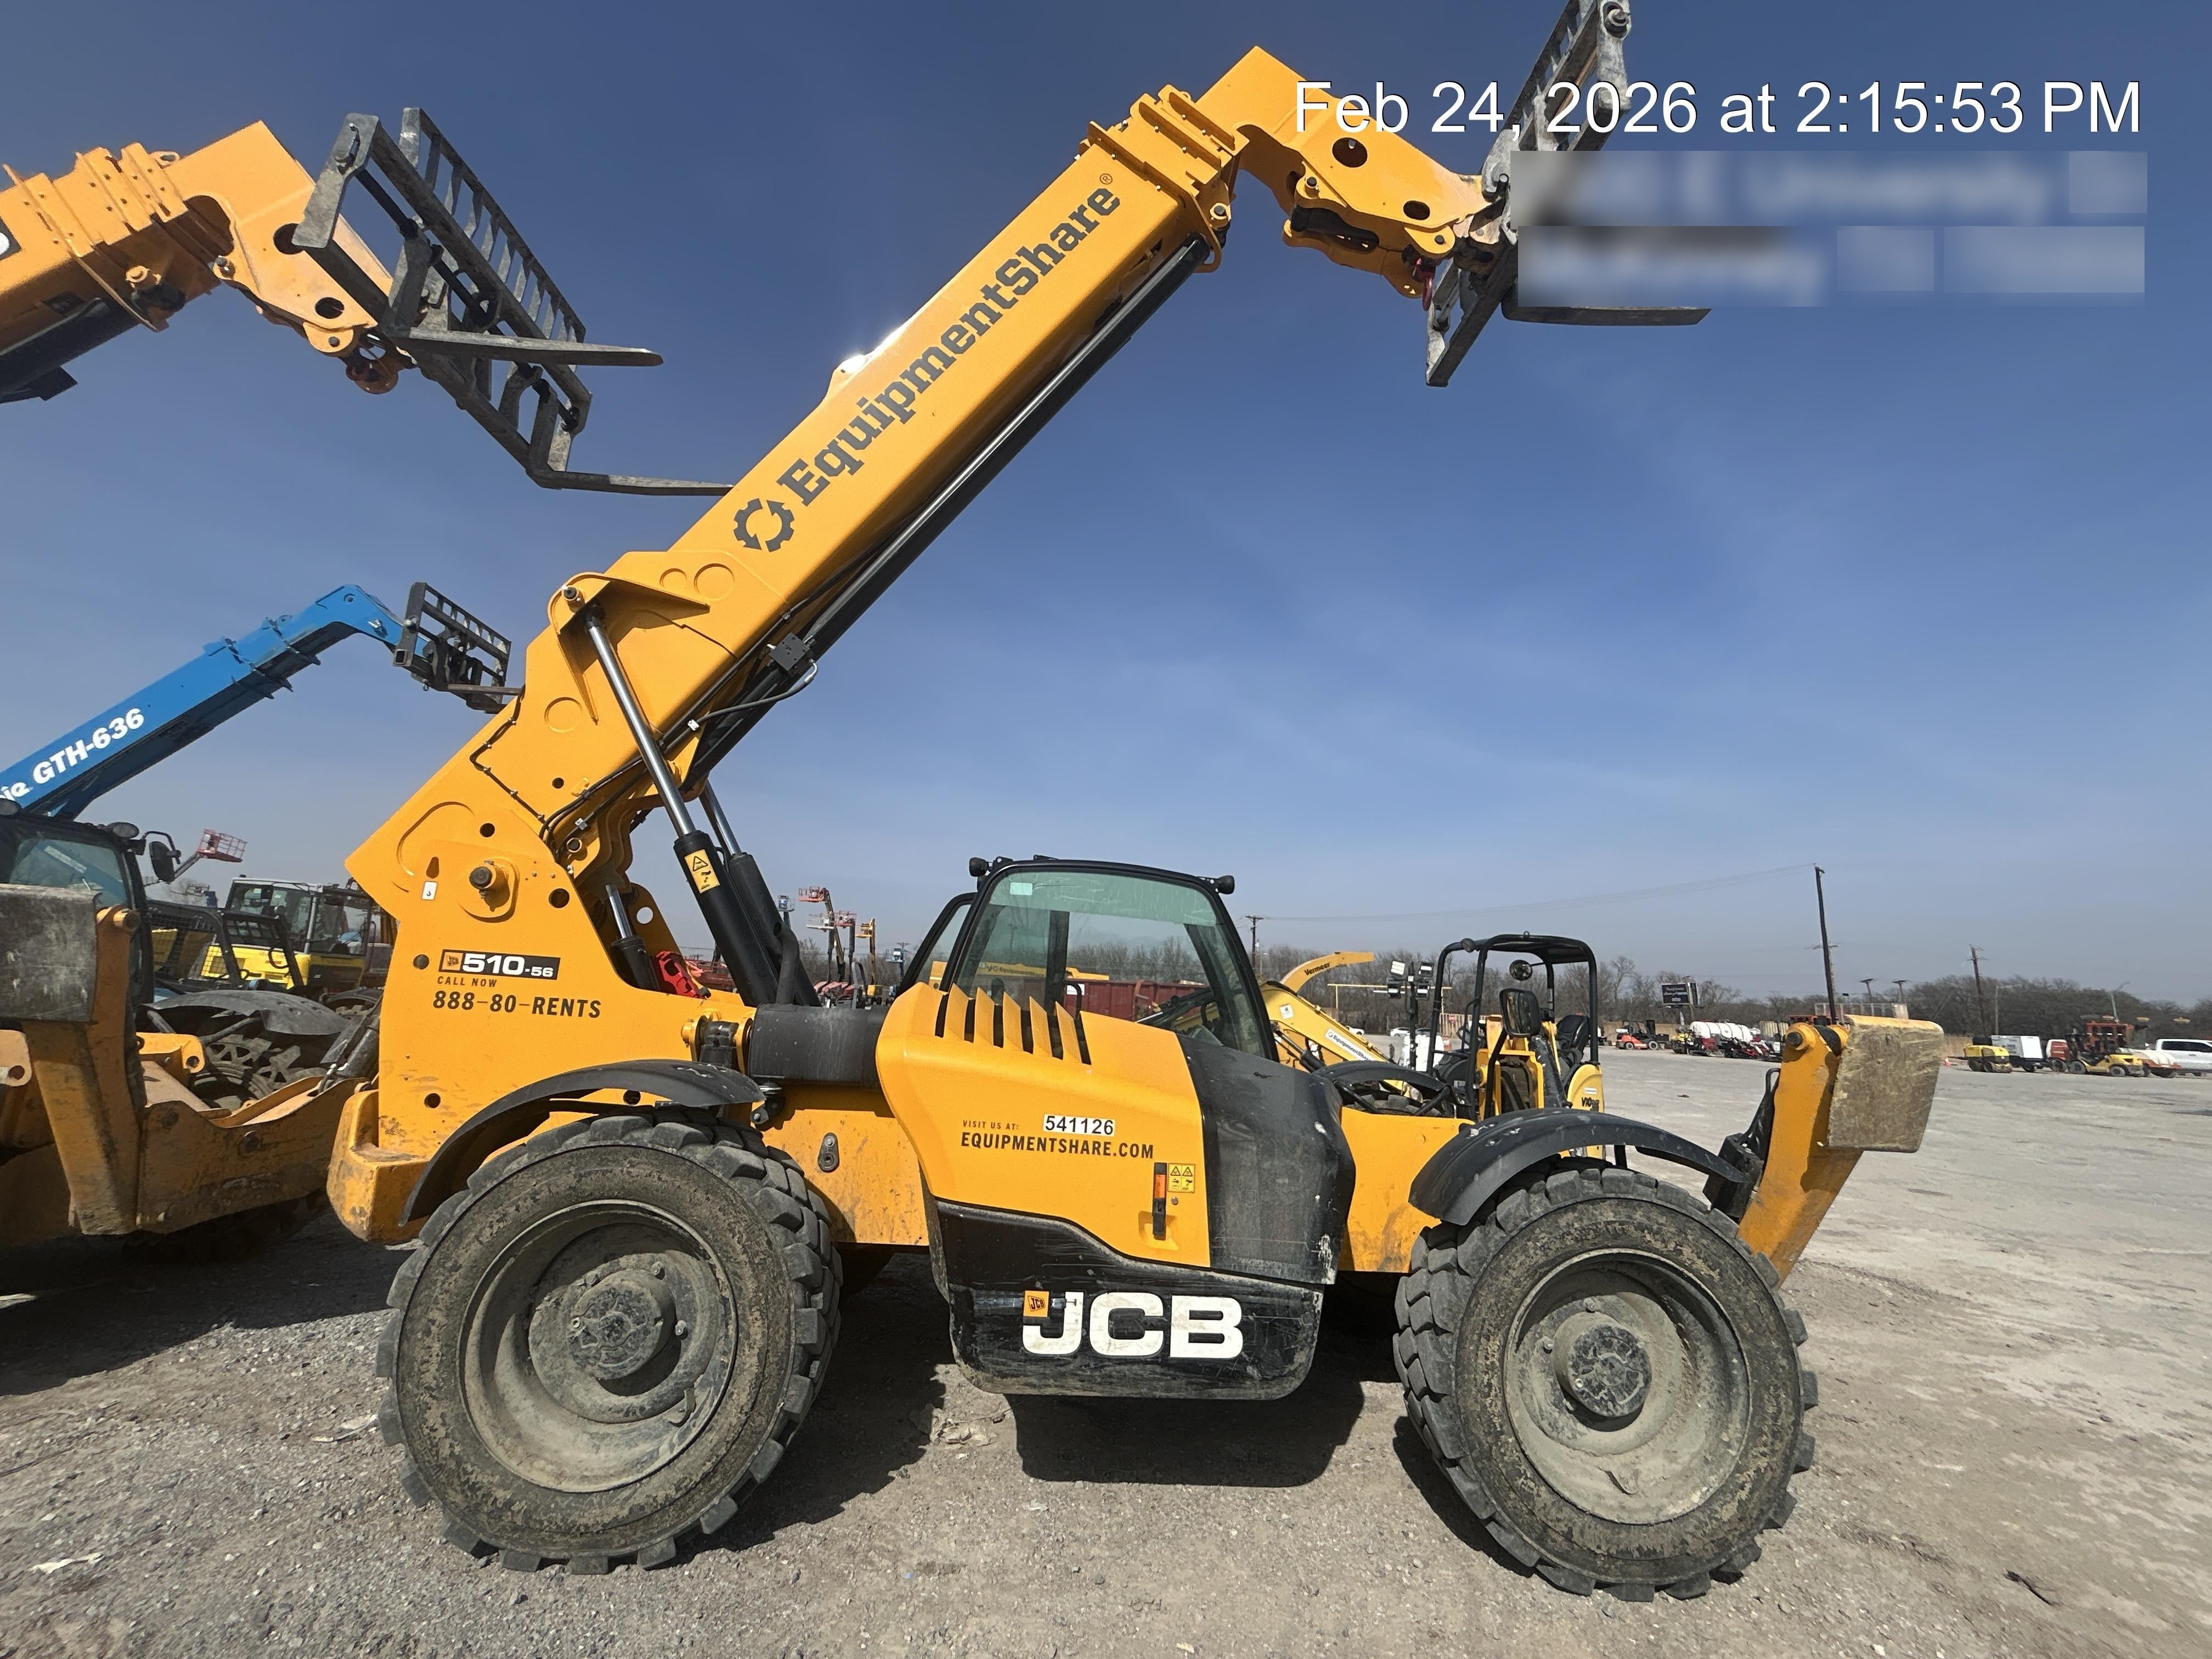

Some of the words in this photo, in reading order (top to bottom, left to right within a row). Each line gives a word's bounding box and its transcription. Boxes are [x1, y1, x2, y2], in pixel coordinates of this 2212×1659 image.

[33, 708, 144, 784] GTH-636
[462, 953, 554, 977] 510-56
[1304, 962, 1330, 975] Vermeer
[437, 975, 466, 986] CALL
[471, 978, 498, 988] NOW
[433, 990, 601, 1018] 888-80-RENTS
[963, 1120, 986, 1129] VISIT
[1045, 1115, 1114, 1135] 541126
[961, 1132, 1154, 1159] EQUIPMENTSHARE.COM
[1031, 1297, 1045, 1310] JCB
[1023, 1291, 1243, 1358] JCB
